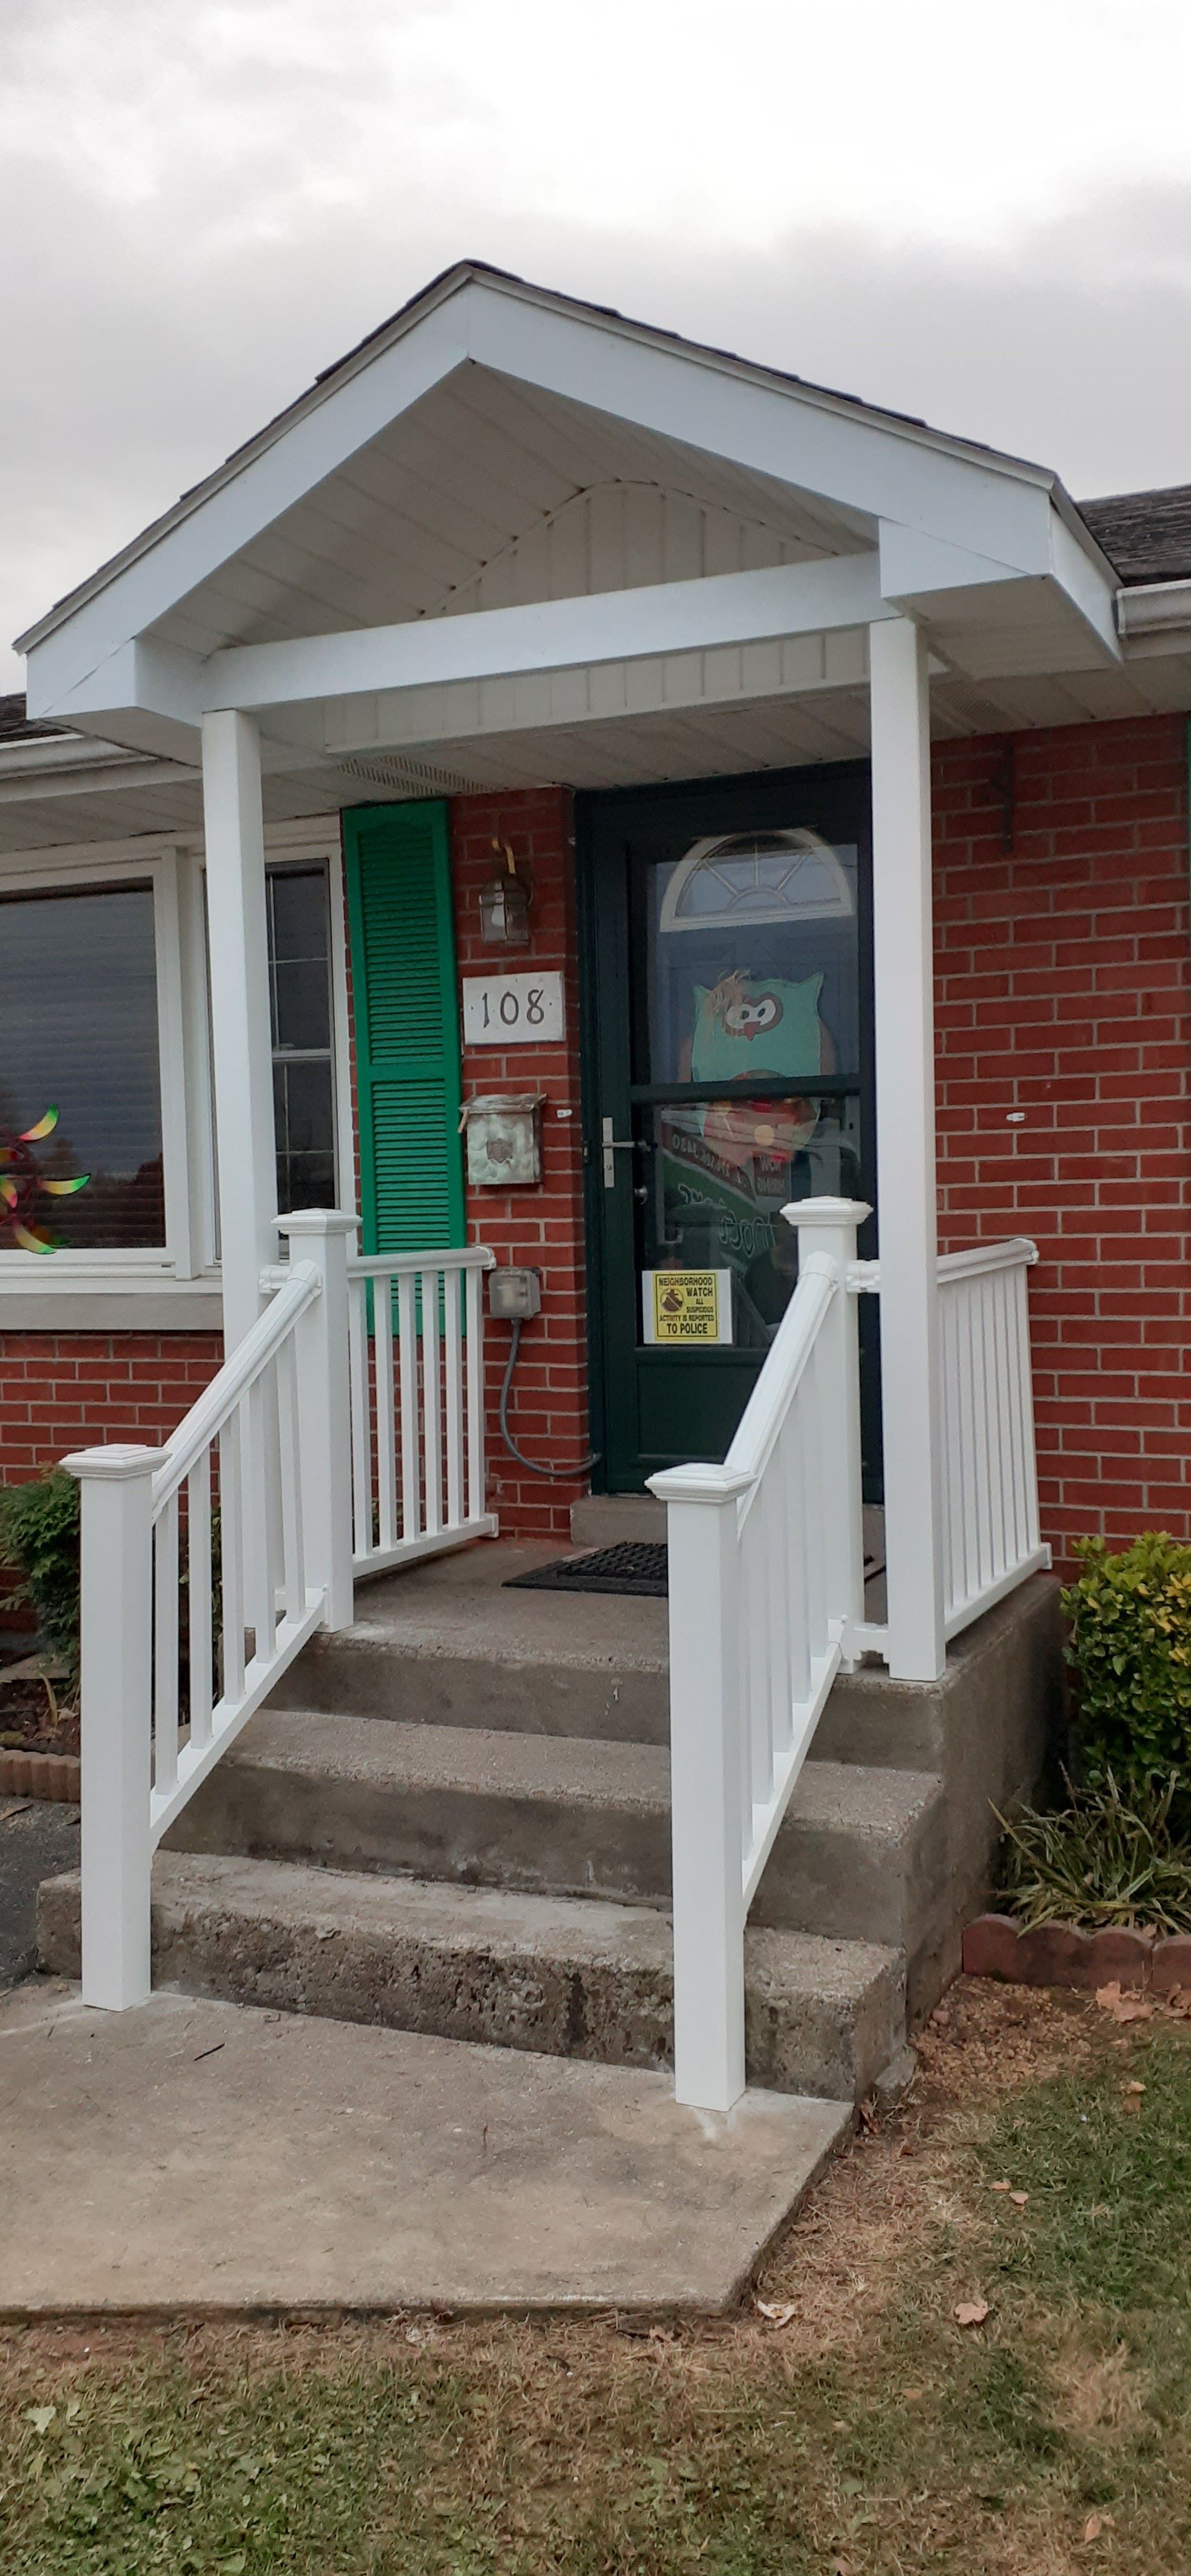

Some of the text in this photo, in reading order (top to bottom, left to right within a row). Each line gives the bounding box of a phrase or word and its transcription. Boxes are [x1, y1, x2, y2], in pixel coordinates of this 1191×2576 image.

[482, 989, 544, 1028] 108
[659, 1277, 713, 1286] NEIGHBORHOOD
[686, 1287, 713, 1297] WATCH
[667, 1323, 708, 1334] TO POLICE
